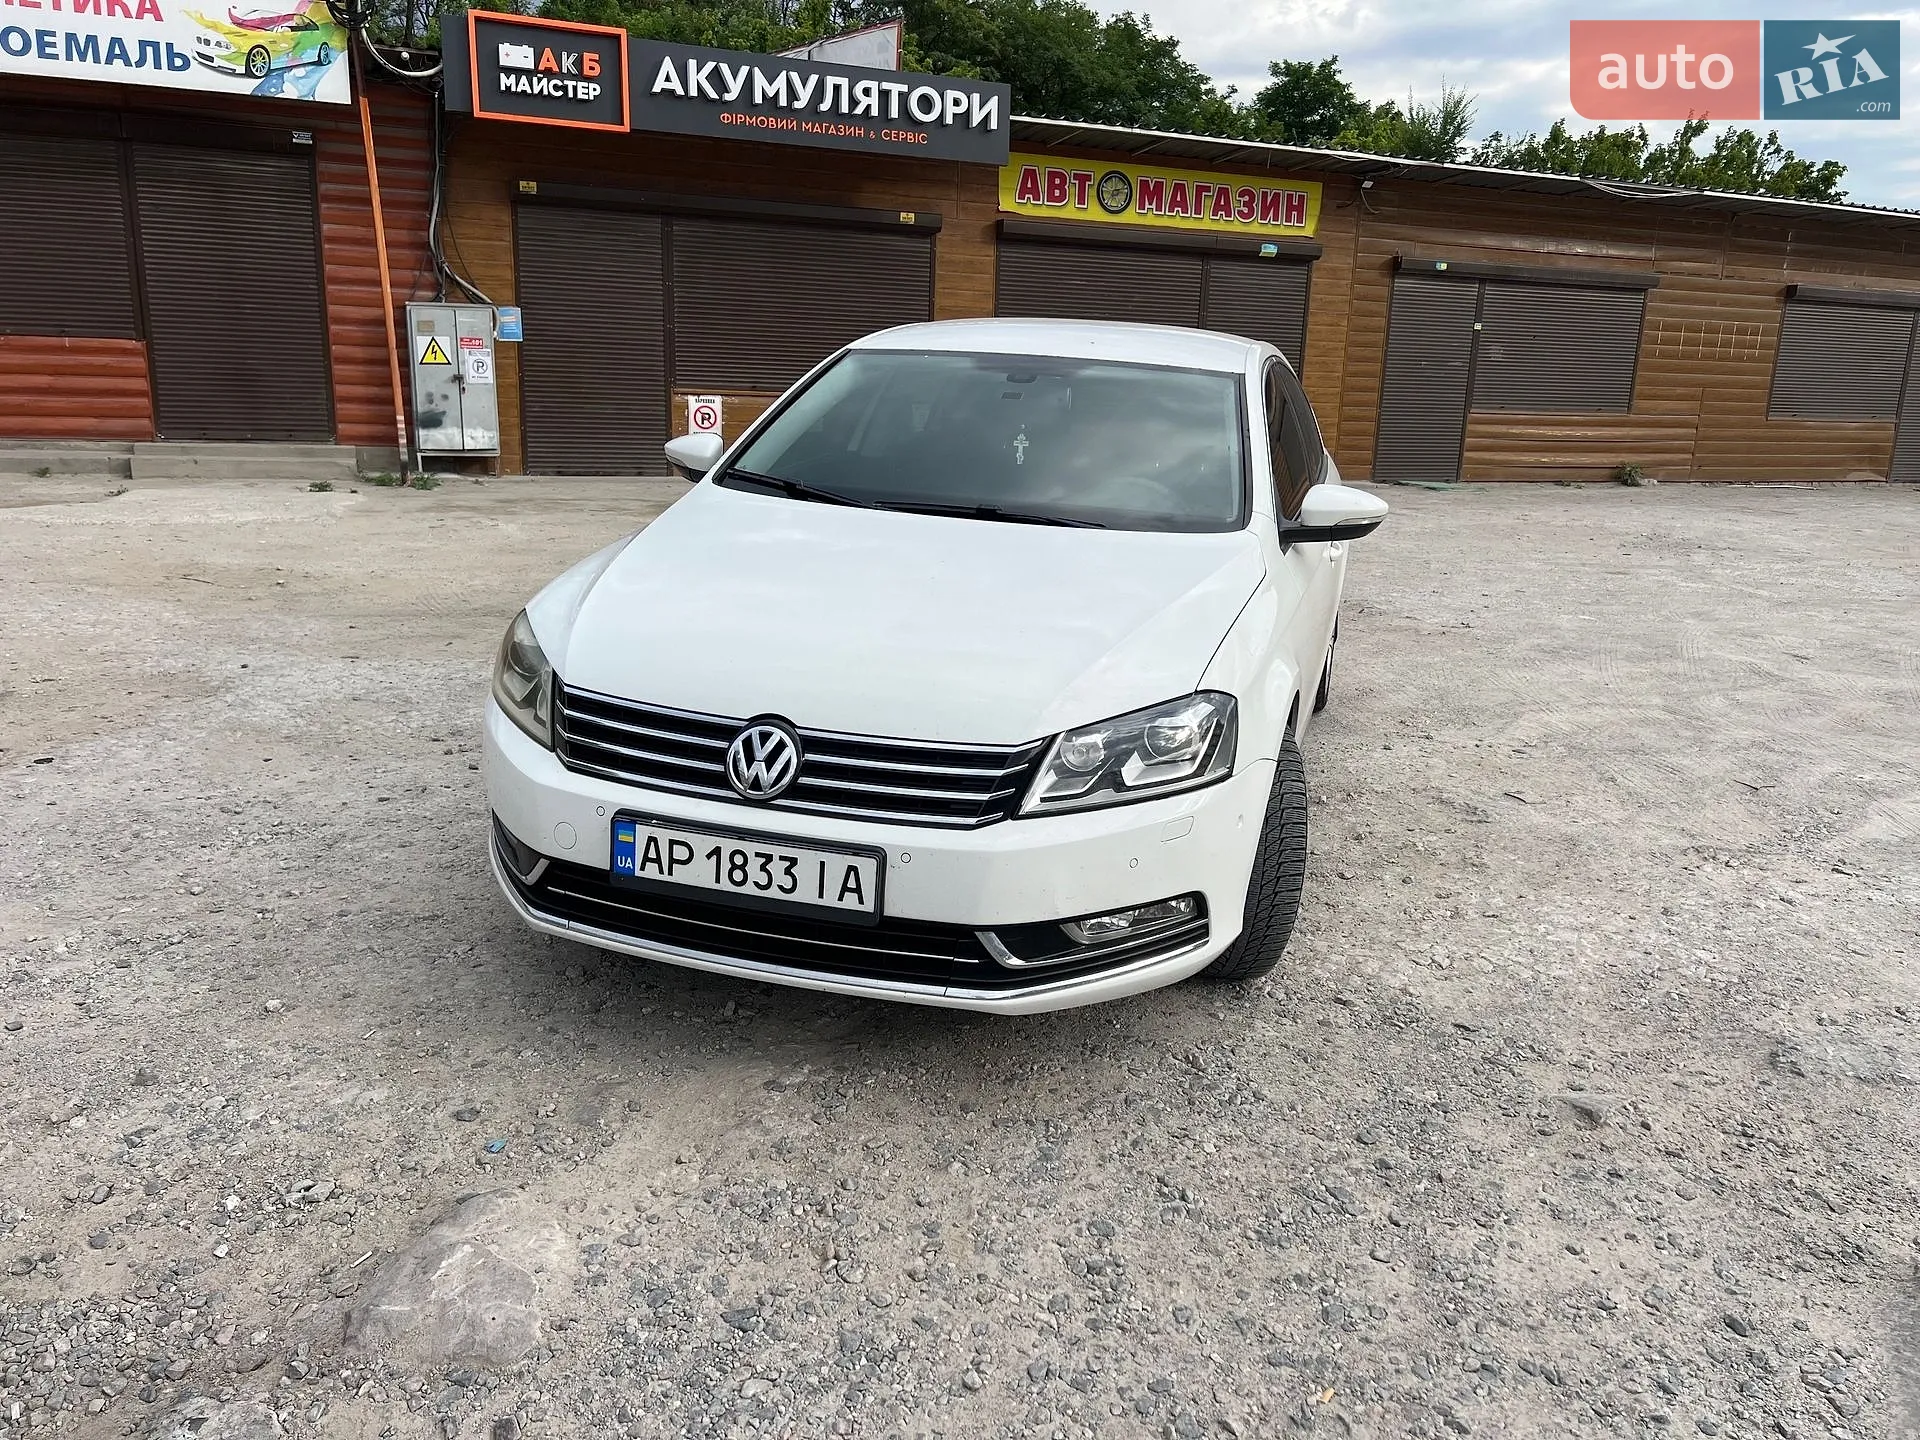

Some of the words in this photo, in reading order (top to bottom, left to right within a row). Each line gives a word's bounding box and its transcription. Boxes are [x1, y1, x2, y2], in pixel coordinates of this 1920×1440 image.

[0, 25, 191, 72] ОЕМАЛЬ
[538, 47, 601, 78] АКБ
[499, 72, 601, 101] МАЙСТЕР
[651, 56, 999, 131] АКУМУЛЯТОРИ
[719, 112, 797, 131] ФІРМОВИЙ
[801, 121, 865, 138] МАГАЗИН
[881, 129, 929, 145] СЕРВІС
[617, 855, 634, 870] UA
[639, 835, 695, 877] AP
[705, 845, 799, 895] 1833
[817, 860, 865, 906] IA
